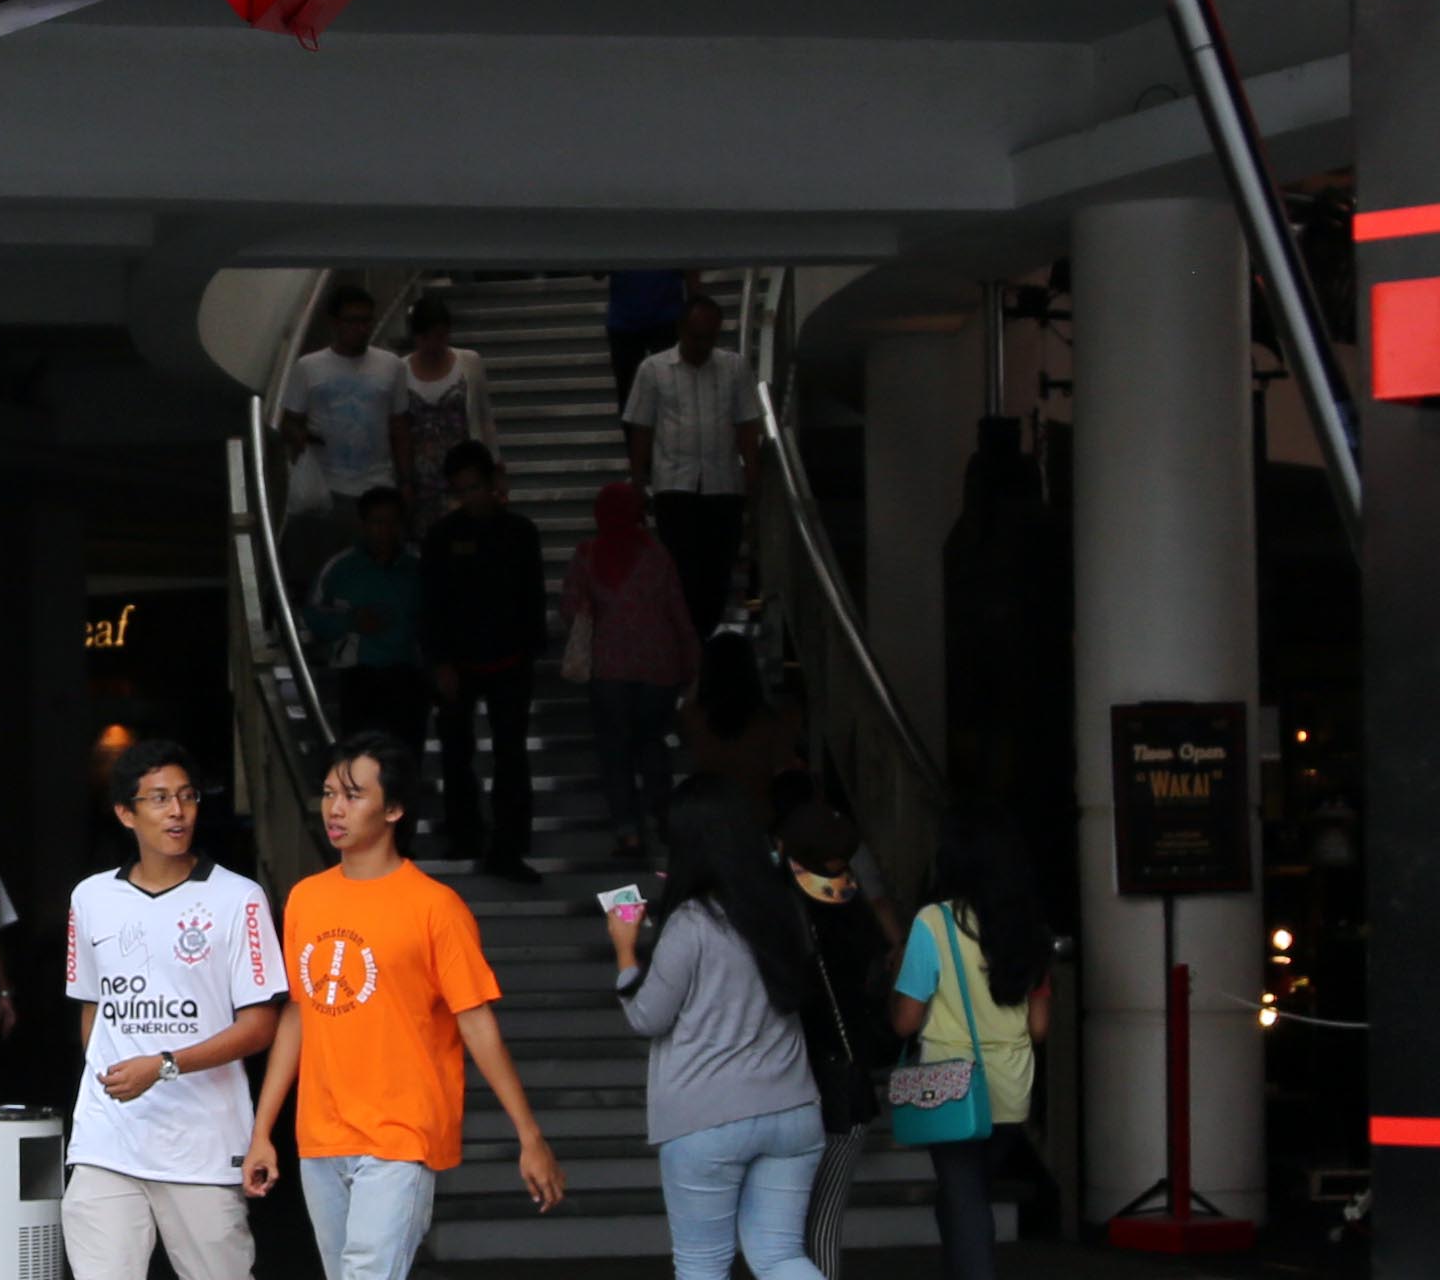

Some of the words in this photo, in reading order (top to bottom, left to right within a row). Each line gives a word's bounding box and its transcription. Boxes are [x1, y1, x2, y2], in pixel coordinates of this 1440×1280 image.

[1178, 741, 1227, 765] Open
[245, 902, 266, 987] bozzano
[330, 940, 346, 976] peace
[101, 975, 147, 995] neo
[103, 993, 198, 1027] química
[121, 1020, 199, 1035] GENÉRICOS
